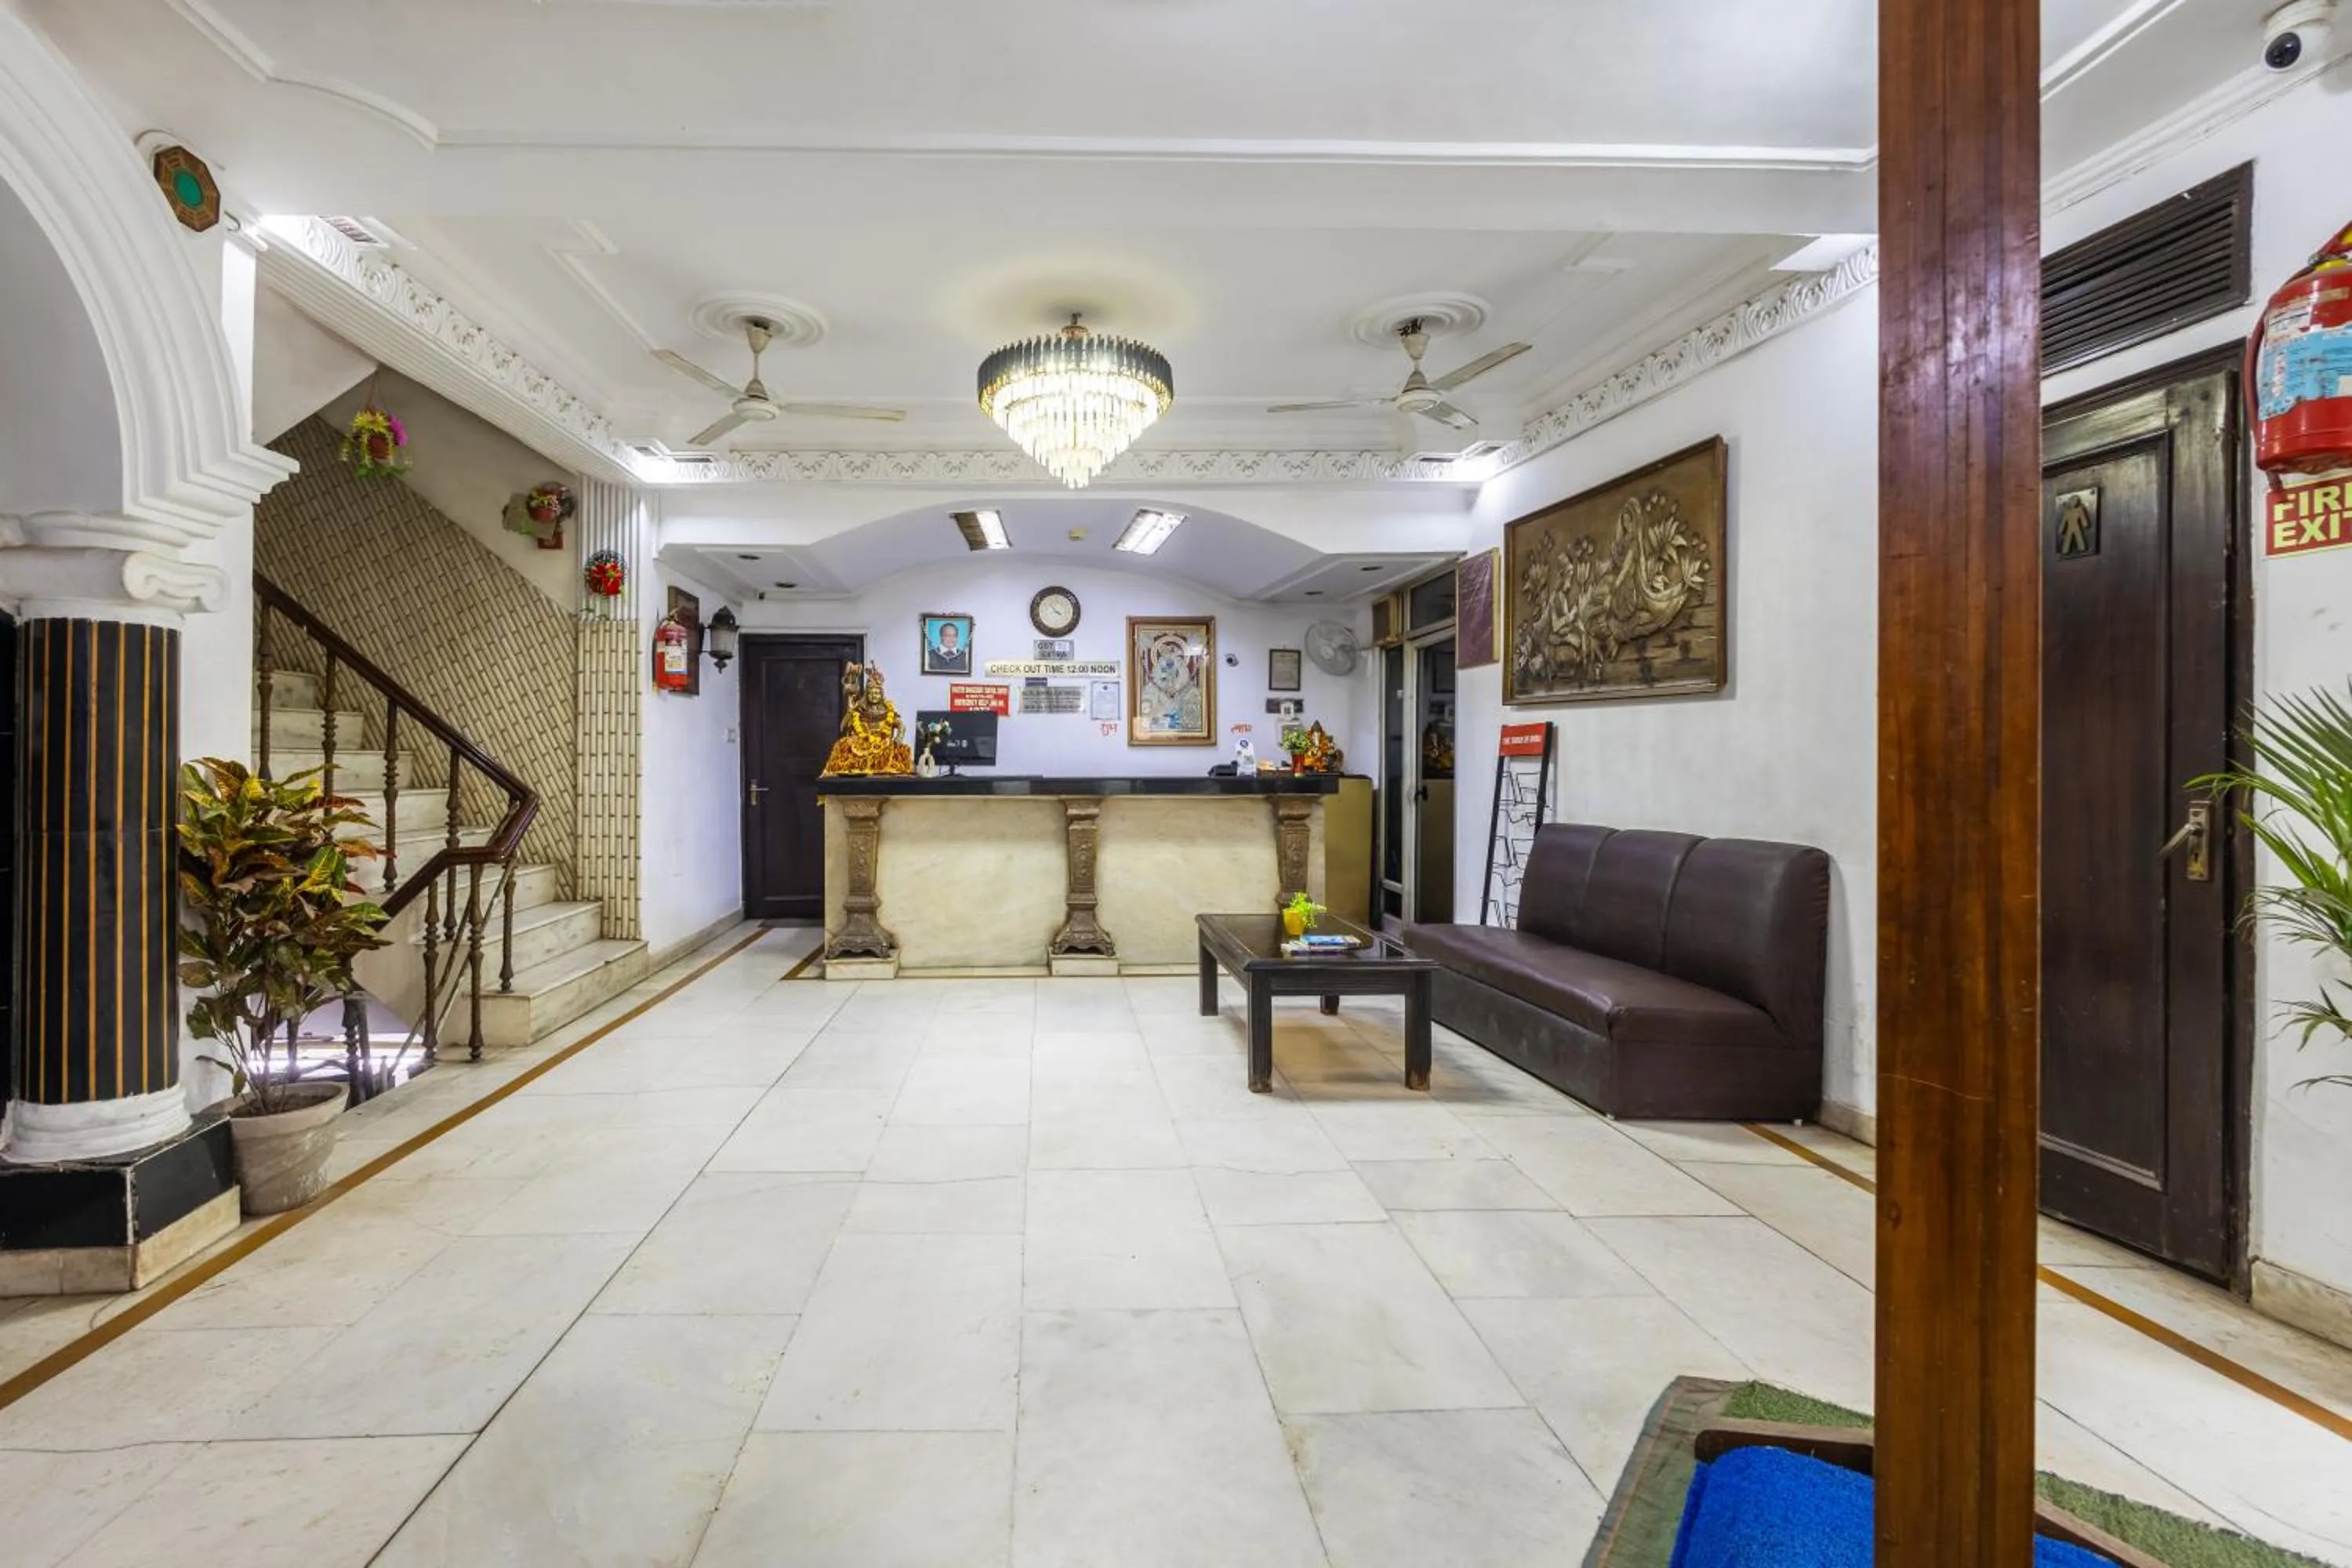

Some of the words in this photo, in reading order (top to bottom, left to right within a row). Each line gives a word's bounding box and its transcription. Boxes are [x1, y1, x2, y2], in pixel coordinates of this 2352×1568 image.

[990, 663, 1022, 673] CHECK
[1023, 664, 1042, 673] OUT
[1044, 664, 1065, 673] TIME
[1067, 664, 1089, 673] 12:00
[1091, 664, 1116, 673] NOON
